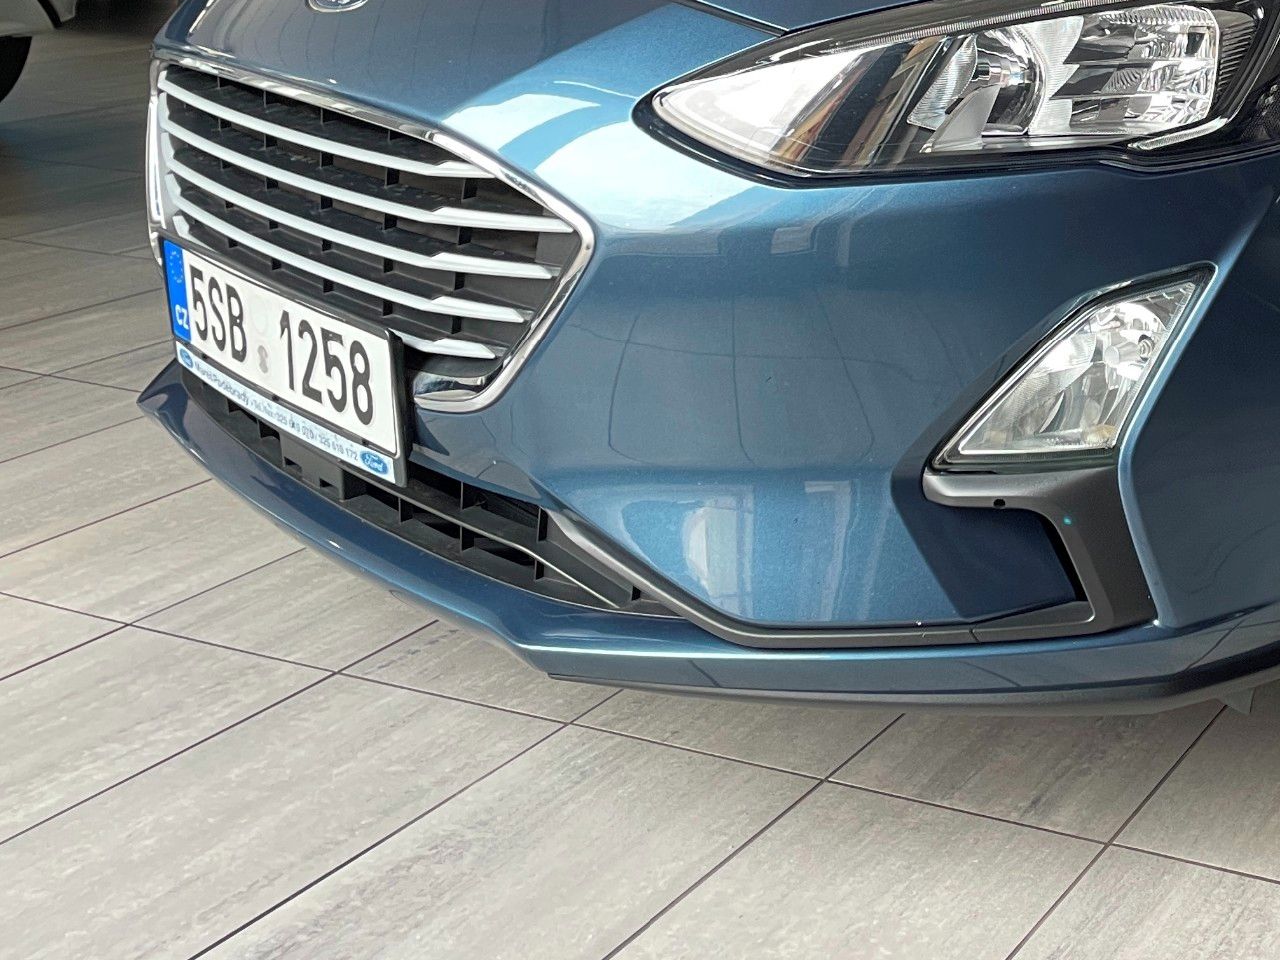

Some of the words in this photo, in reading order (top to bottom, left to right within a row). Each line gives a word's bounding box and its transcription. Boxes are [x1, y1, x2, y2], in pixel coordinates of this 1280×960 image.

[175, 304, 190, 331] CZ
[189, 263, 248, 363] 5SB
[279, 309, 374, 426] 1258
